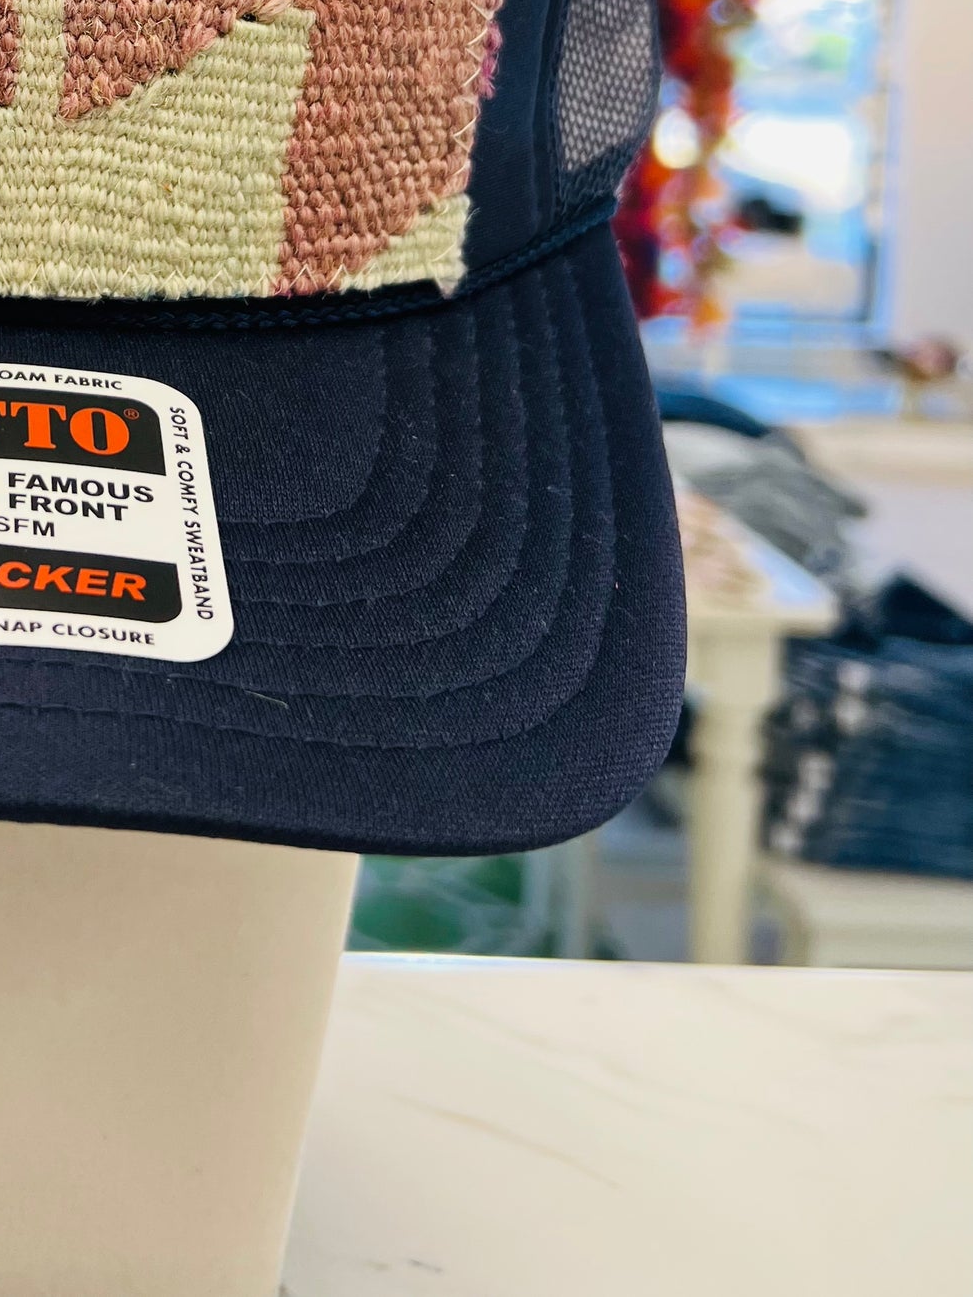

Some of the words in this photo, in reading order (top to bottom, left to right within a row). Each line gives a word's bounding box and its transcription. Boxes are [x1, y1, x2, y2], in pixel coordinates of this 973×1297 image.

[54, 374, 123, 390] FABRIC
[170, 407, 188, 442] SOFT
[175, 446, 191, 455] &
[8, 472, 155, 503] FAMOUS
[175, 460, 199, 516] COMFY
[9, 493, 128, 521] FRONT
[184, 520, 214, 620] SWEATBAND
[52, 622, 156, 645] CLOSURE
